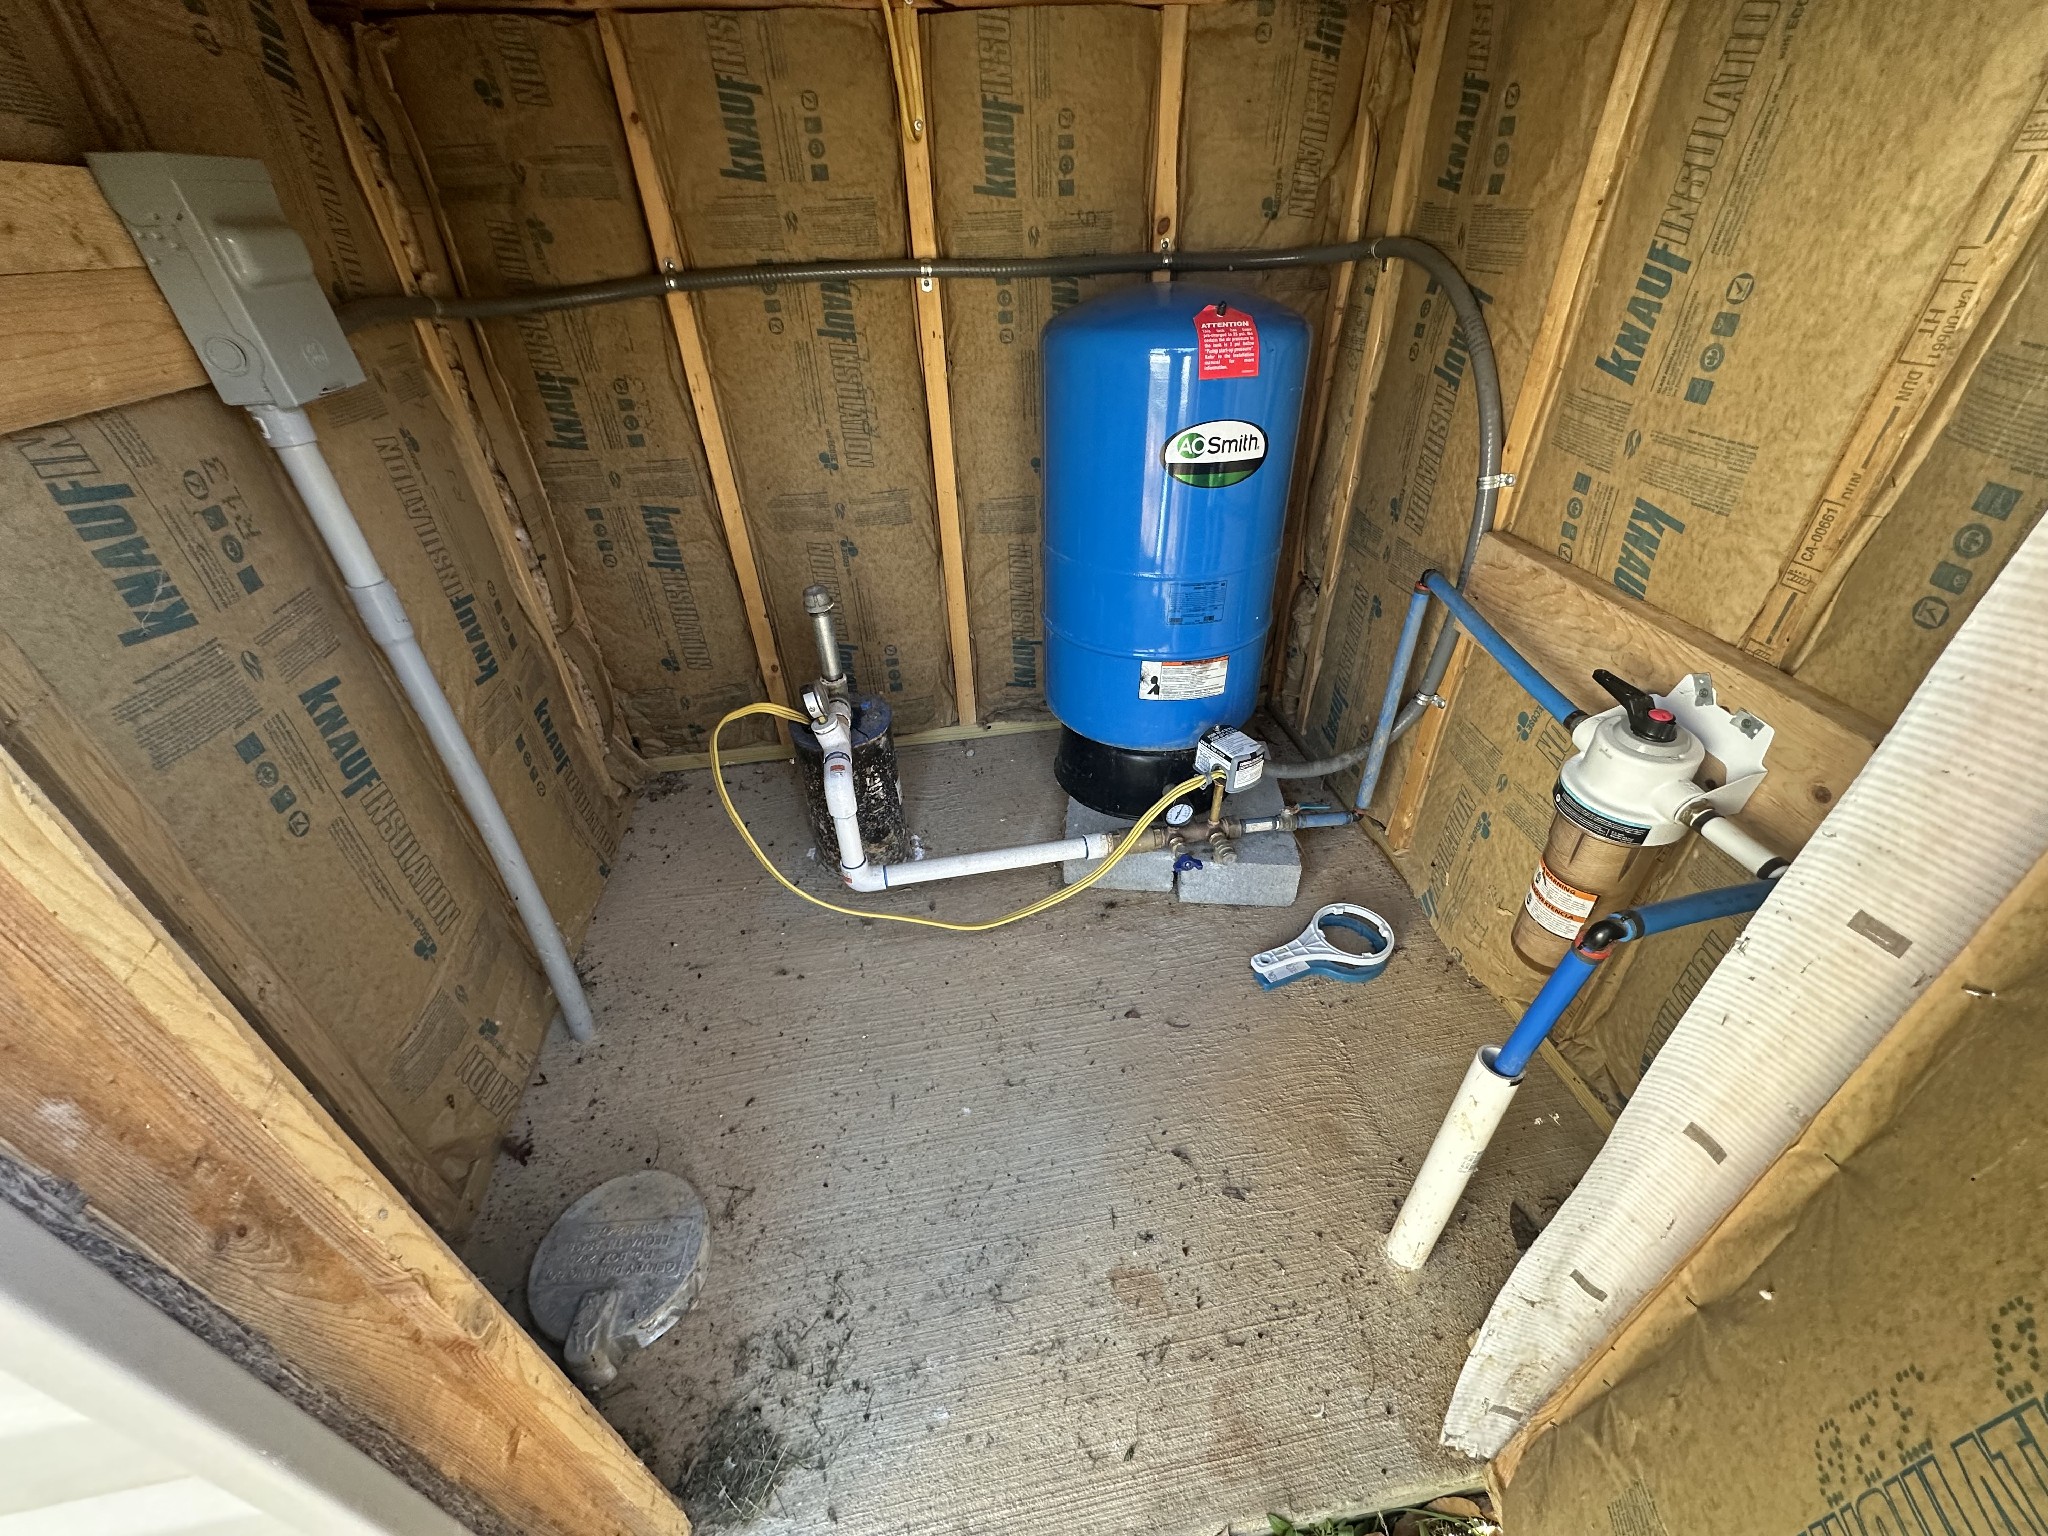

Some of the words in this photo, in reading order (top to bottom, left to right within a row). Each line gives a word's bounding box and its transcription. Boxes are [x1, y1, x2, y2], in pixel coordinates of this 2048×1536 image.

[716, 73, 767, 182] KNAUF
[973, 94, 1024, 198] KNAUF
[1437, 72, 1490, 194] KNAUF
[1595, 238, 1692, 387] KNAUF
[1654, 0, 1781, 246] INSULATIO
[817, 281, 857, 344] NAUF
[535, 370, 590, 451] KNAUF
[829, 342, 875, 468] INSULATION
[1404, 383, 1458, 537] INSULATION
[46, 482, 200, 647] KNAUF
[372, 436, 465, 598] INSULATION
[640, 504, 686, 572] KNAUF
[1614, 496, 1686, 600] KNAU
[1801, 507, 1838, 562] CA-00661
[450, 592, 499, 687] KNAUF
[1005, 637, 1043, 688] KNAUF
[534, 697, 572, 775] KNAUF
[300, 675, 382, 800] KNAUF
[360, 780, 462, 936] INSULATION
